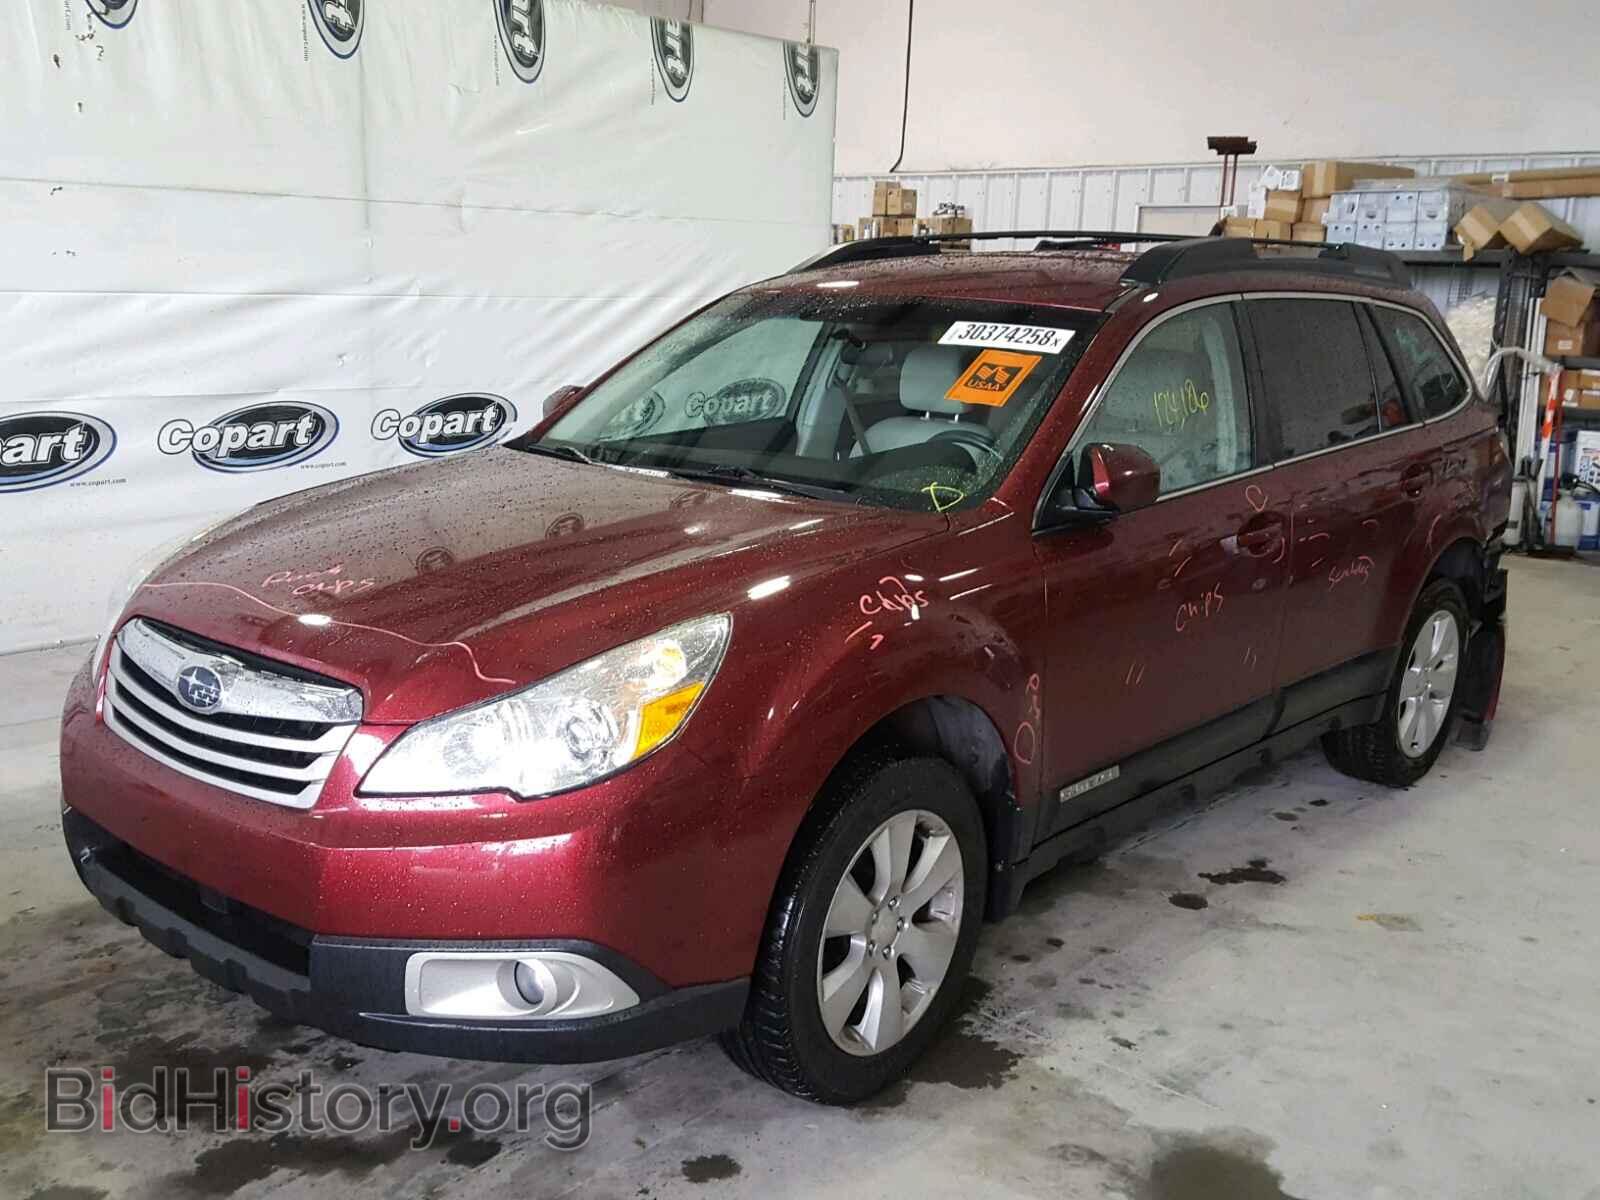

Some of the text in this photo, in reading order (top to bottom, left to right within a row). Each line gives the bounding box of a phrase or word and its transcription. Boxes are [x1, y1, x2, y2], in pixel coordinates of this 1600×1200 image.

[967, 378, 1001, 392] USAA
[0, 422, 87, 466] art
[157, 411, 316, 459] Copart
[371, 401, 498, 445] Copart
